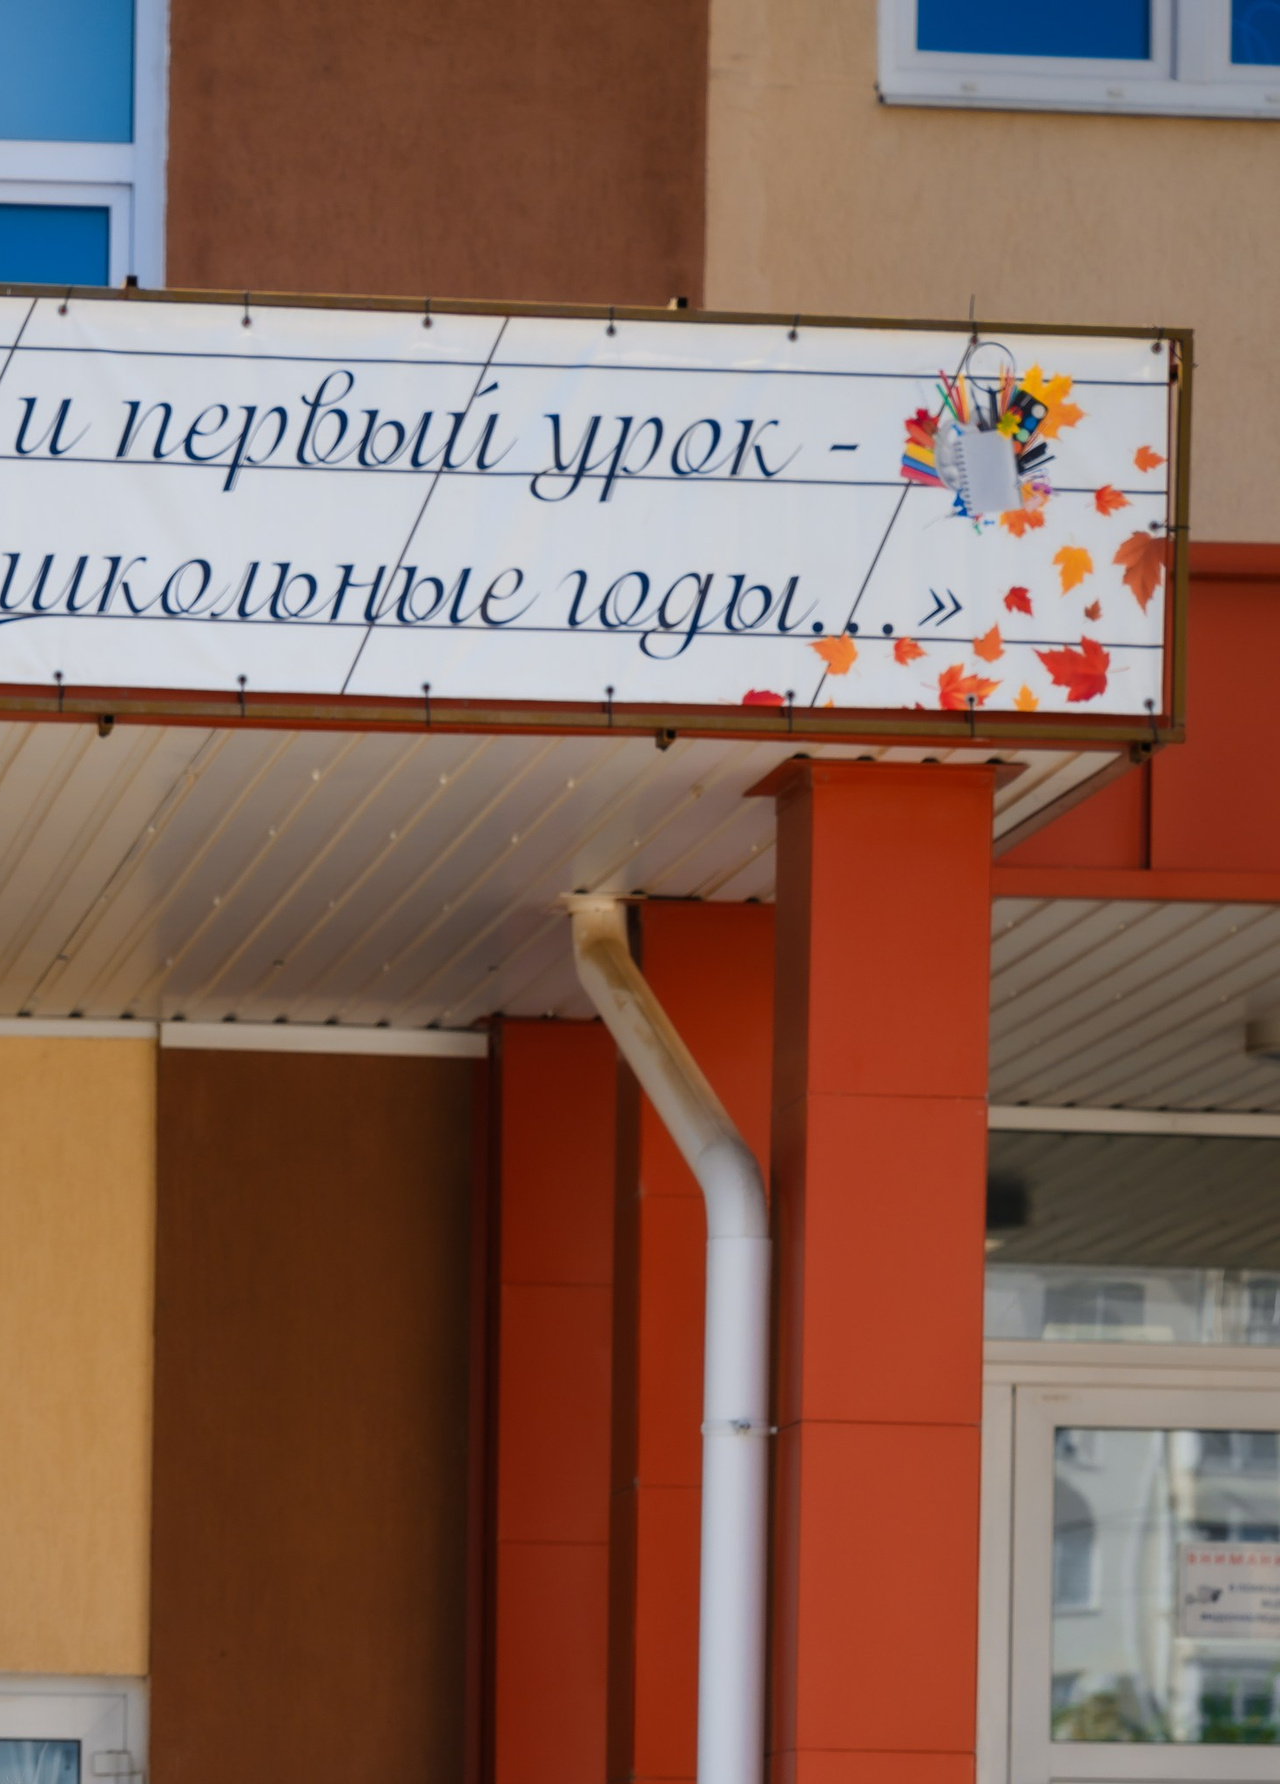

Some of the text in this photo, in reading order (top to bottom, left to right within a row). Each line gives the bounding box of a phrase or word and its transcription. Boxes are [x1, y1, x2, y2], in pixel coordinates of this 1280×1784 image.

[15, 396, 91, 456] и
[116, 370, 519, 492] первый
[530, 413, 803, 502] урок
